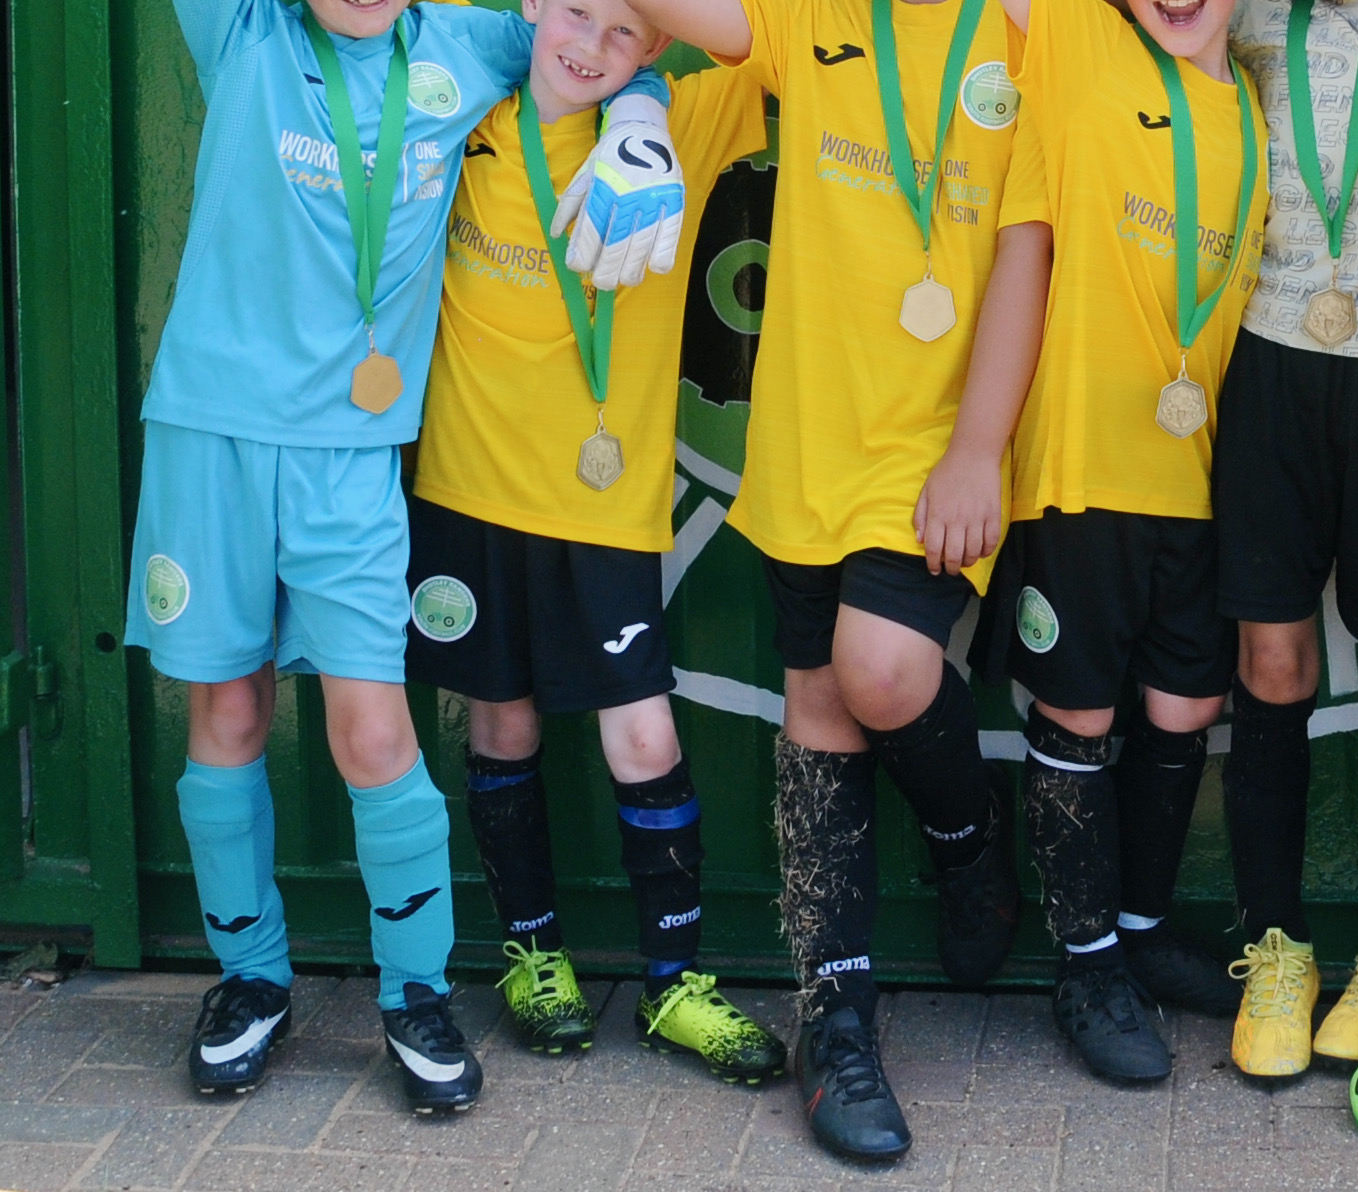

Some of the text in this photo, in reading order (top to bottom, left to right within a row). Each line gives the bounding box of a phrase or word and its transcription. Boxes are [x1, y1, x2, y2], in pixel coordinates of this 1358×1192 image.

[415, 141, 442, 160] ONE
[945, 159, 970, 179] ONE
[449, 211, 550, 274] WORKHORSE
